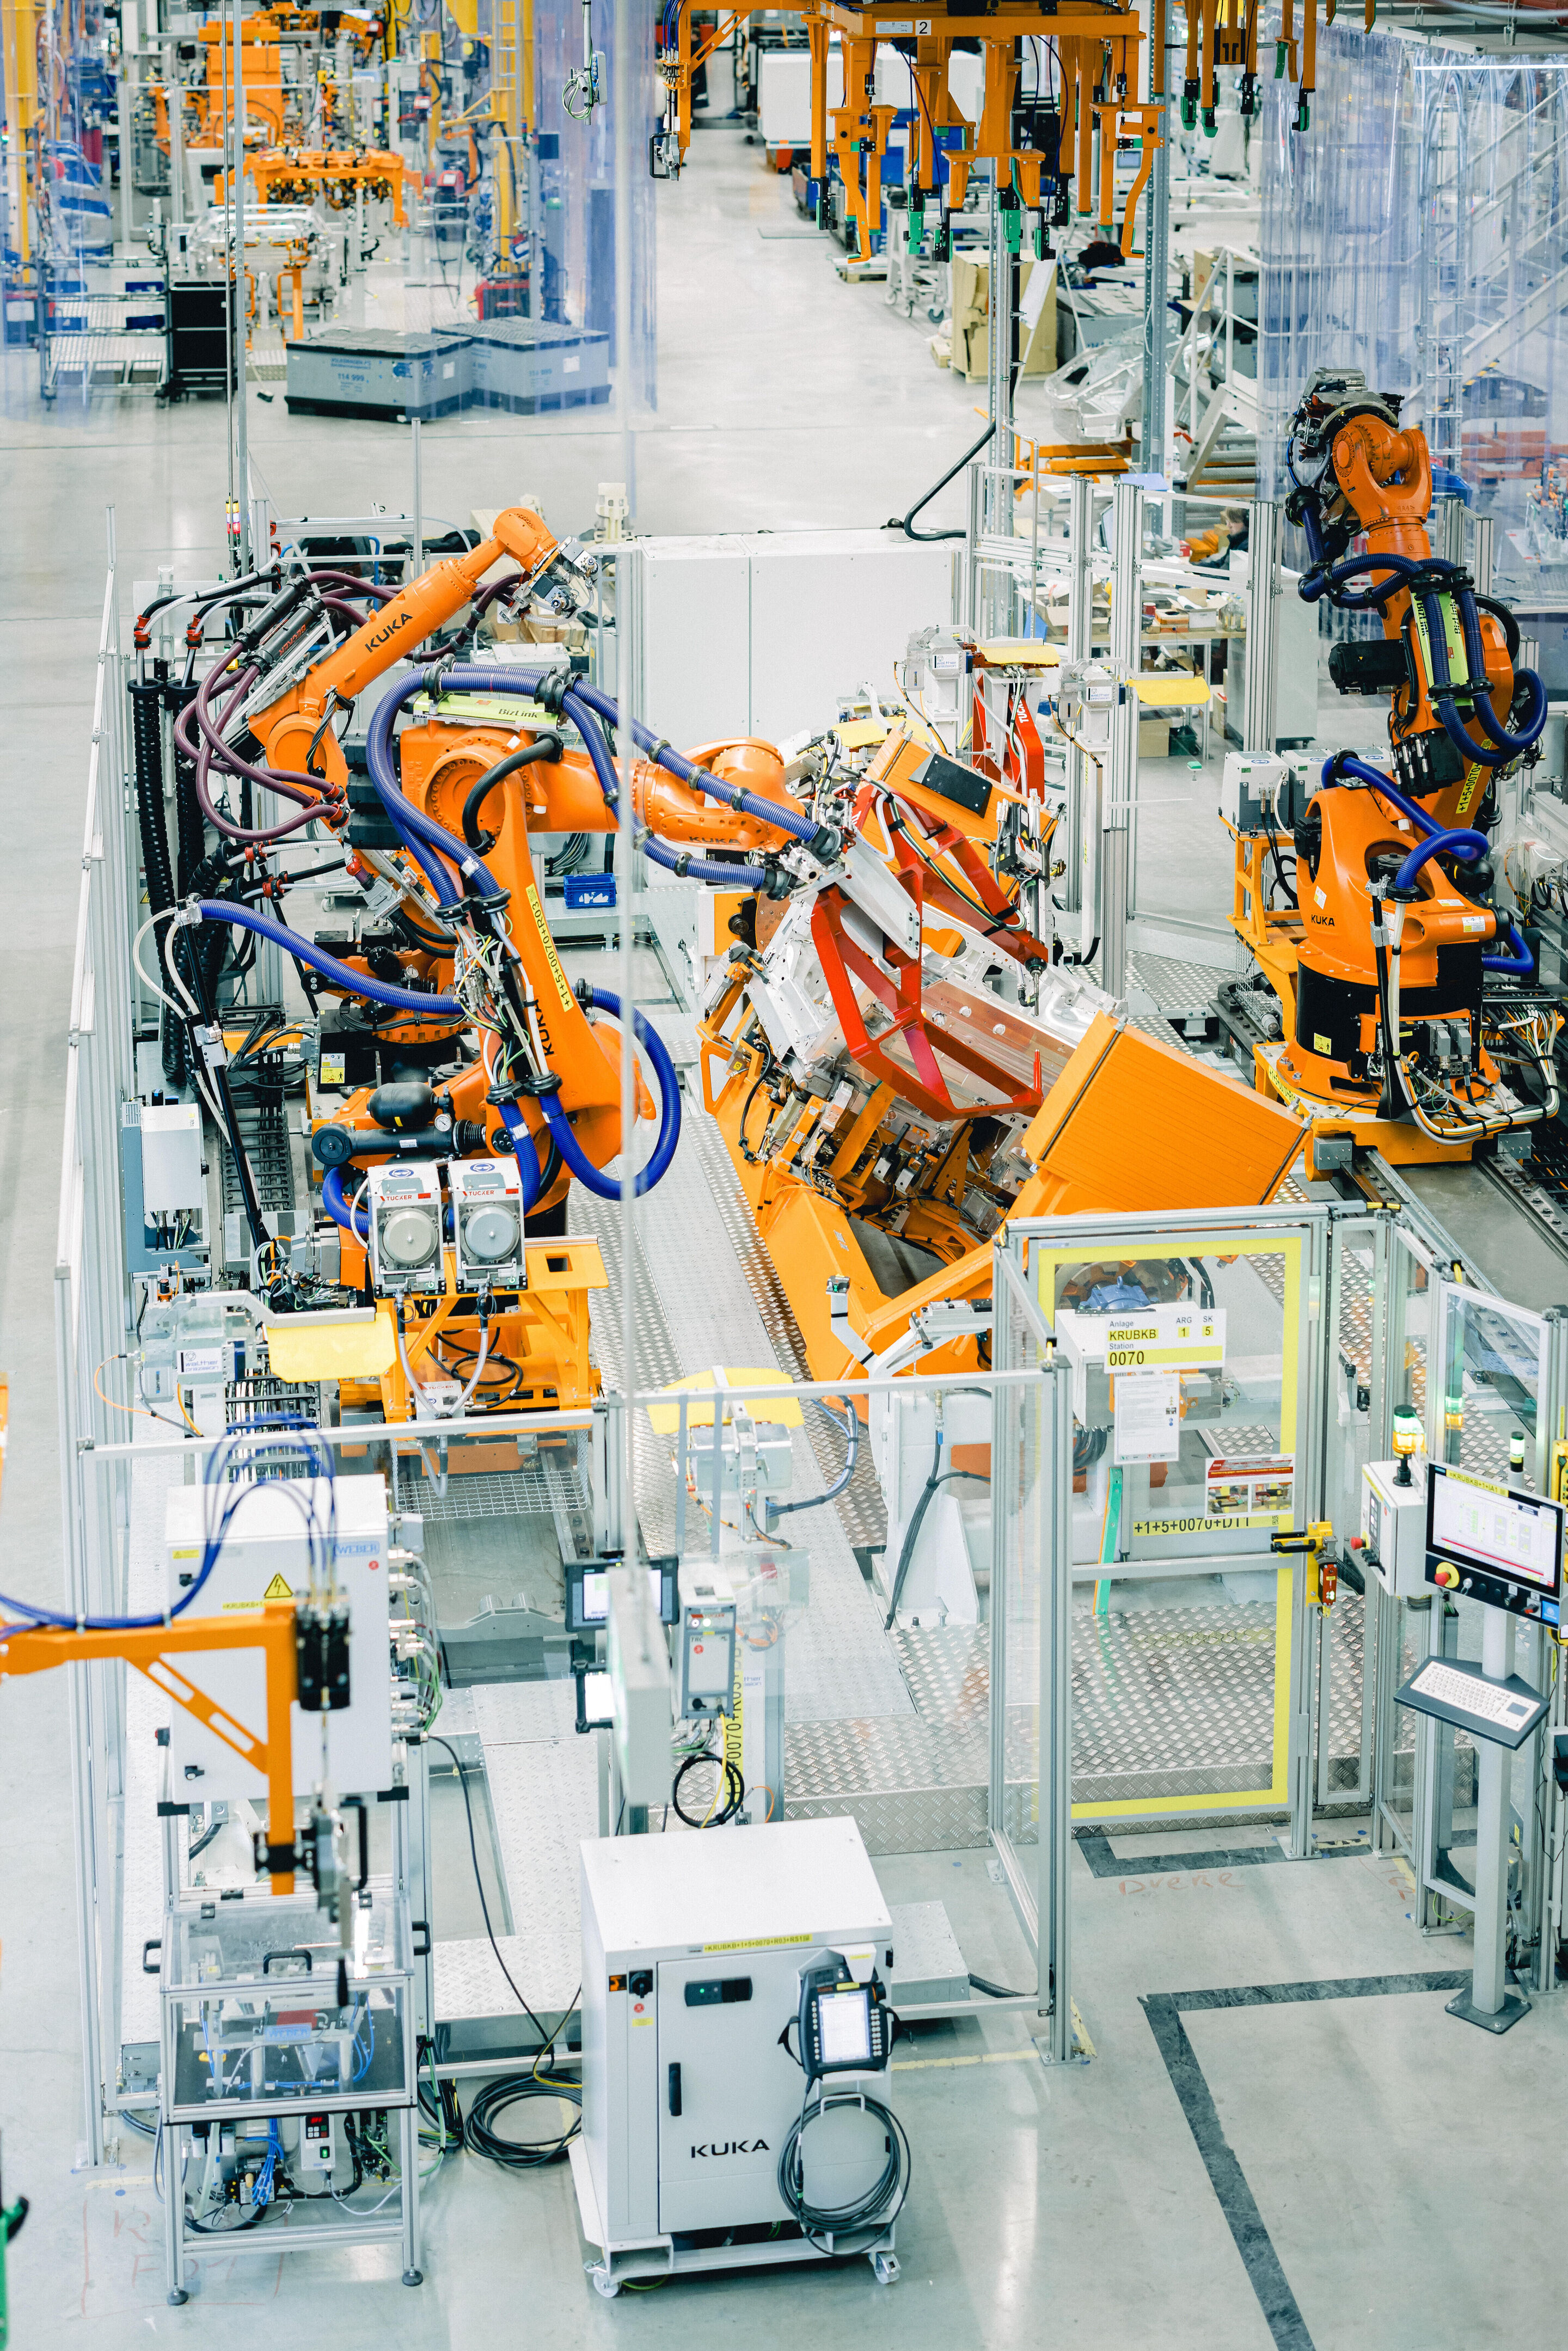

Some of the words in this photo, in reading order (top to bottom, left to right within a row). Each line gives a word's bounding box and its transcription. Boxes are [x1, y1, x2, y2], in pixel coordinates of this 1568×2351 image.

[918, 21, 928, 34] 2
[365, 613, 413, 653] KUKA
[498, 708, 538, 718] BizLink
[688, 836, 741, 845] KUKA
[1310, 914, 1336, 927] KUKA
[532, 901, 571, 1007] +1+5+0070+R03
[536, 999, 554, 1056] KUKA
[1110, 1329, 1156, 1340] KRUBKB
[1181, 1327, 1186, 1337] 1
[1205, 1326, 1211, 1336] 5
[1110, 1351, 1144, 1366] 0070
[338, 1544, 376, 1555] WEBER
[691, 2139, 770, 2158] KUKA
